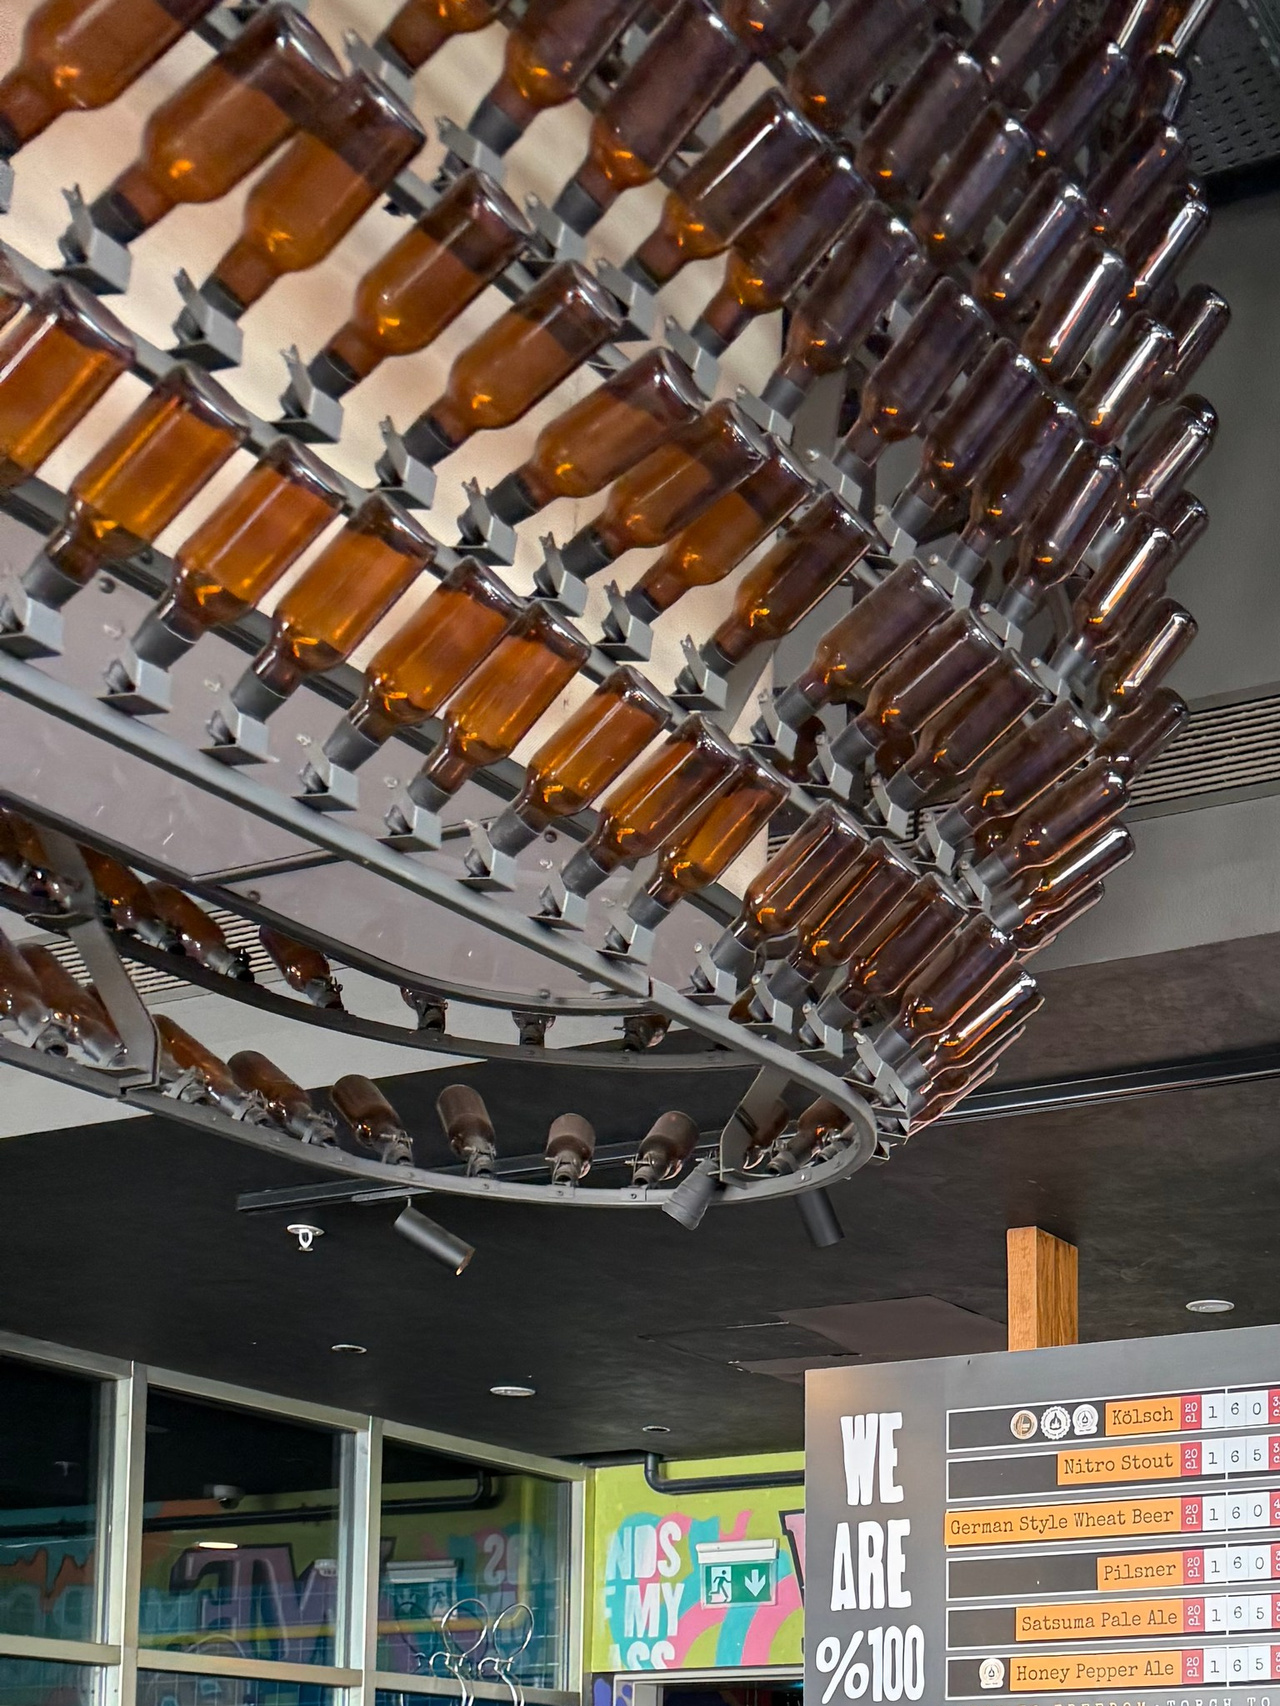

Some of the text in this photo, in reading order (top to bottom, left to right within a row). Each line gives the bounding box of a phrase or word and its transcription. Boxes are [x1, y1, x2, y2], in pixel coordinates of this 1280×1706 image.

[1112, 1405, 1174, 1425] Kölsch
[1184, 1402, 1197, 1412] 20
[840, 1412, 904, 1506] WE
[1064, 1451, 1173, 1475] Nitro Stout
[1185, 1449, 1198, 1460] 20
[1185, 1504, 1198, 1515] 20
[951, 1506, 1173, 1537] German Style Wheat Beer
[830, 1519, 912, 1611] ARE
[1103, 1559, 1177, 1579] Pilsner
[1187, 1557, 1199, 1567] 20
[1022, 1607, 1178, 1633] Satsuma Pale Ale
[1187, 1606, 1199, 1616] 20
[816, 1625, 925, 1704] %100
[1016, 1663, 1070, 1686] Honey
[1075, 1661, 1139, 1683] Pepper
[1145, 1657, 1174, 1676] Ale
[1186, 1657, 1199, 1667] 20
